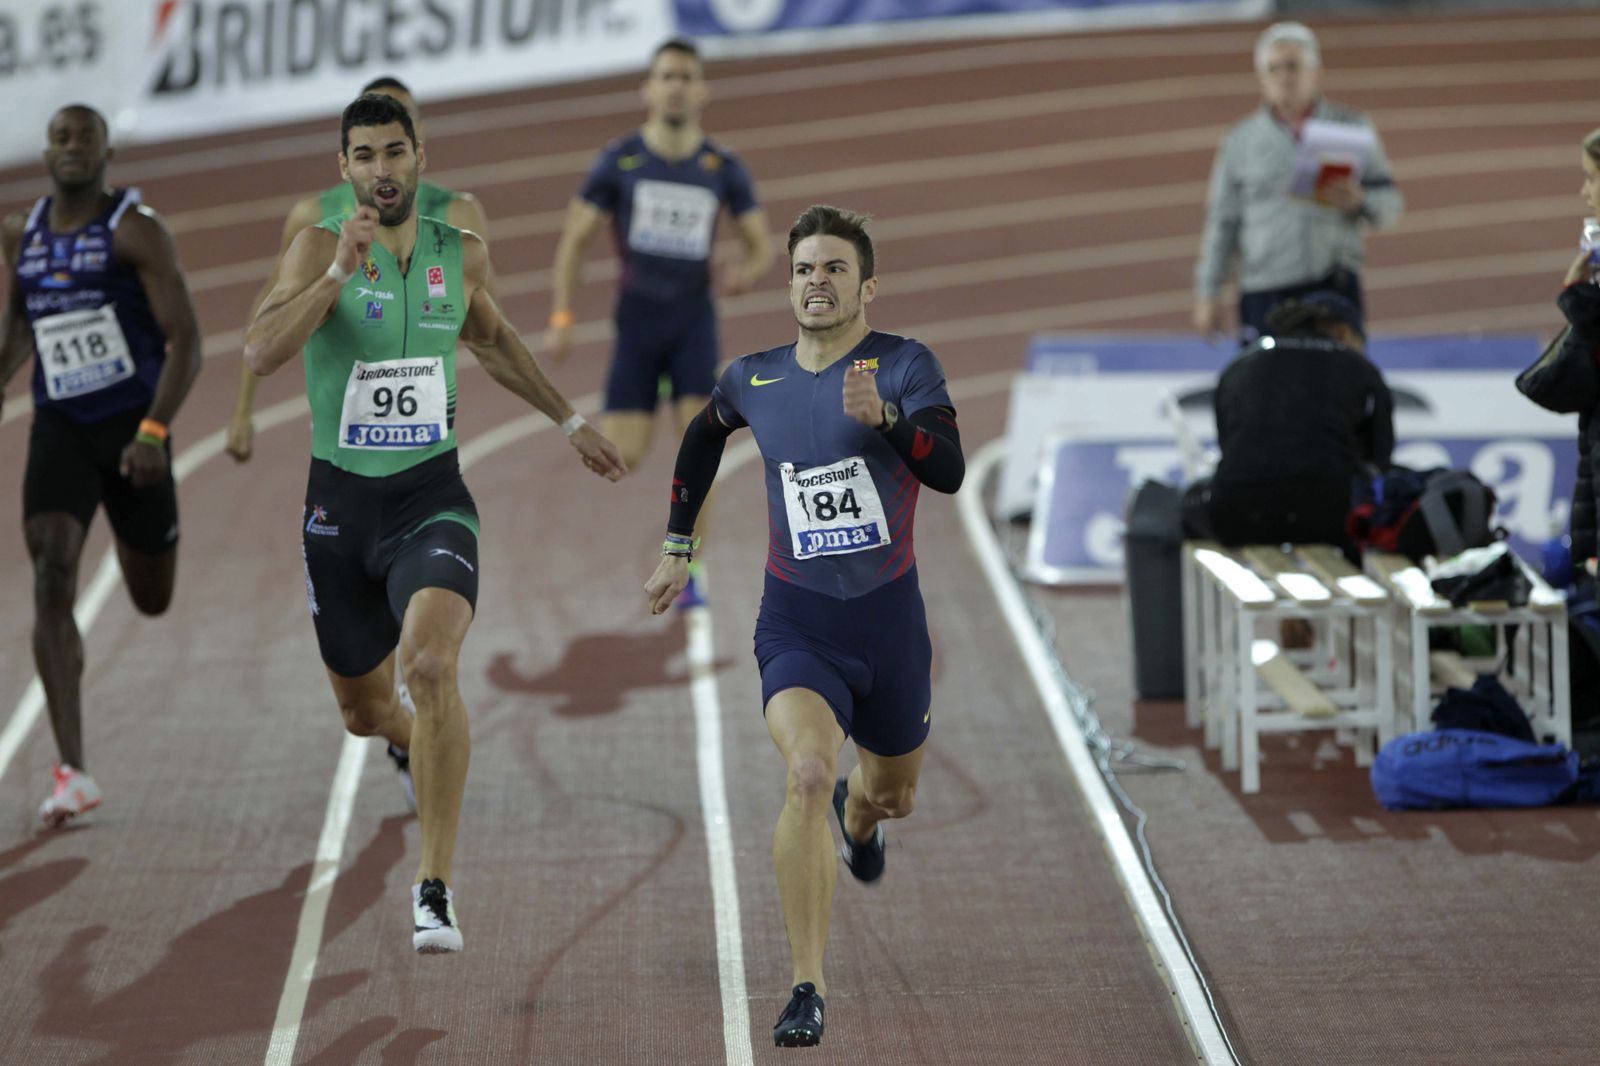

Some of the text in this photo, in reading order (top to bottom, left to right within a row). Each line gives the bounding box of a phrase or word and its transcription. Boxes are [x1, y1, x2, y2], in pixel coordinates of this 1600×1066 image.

[52, 332, 107, 365] 418
[357, 365, 436, 381] BRIDGESTONE
[373, 385, 418, 418] 96
